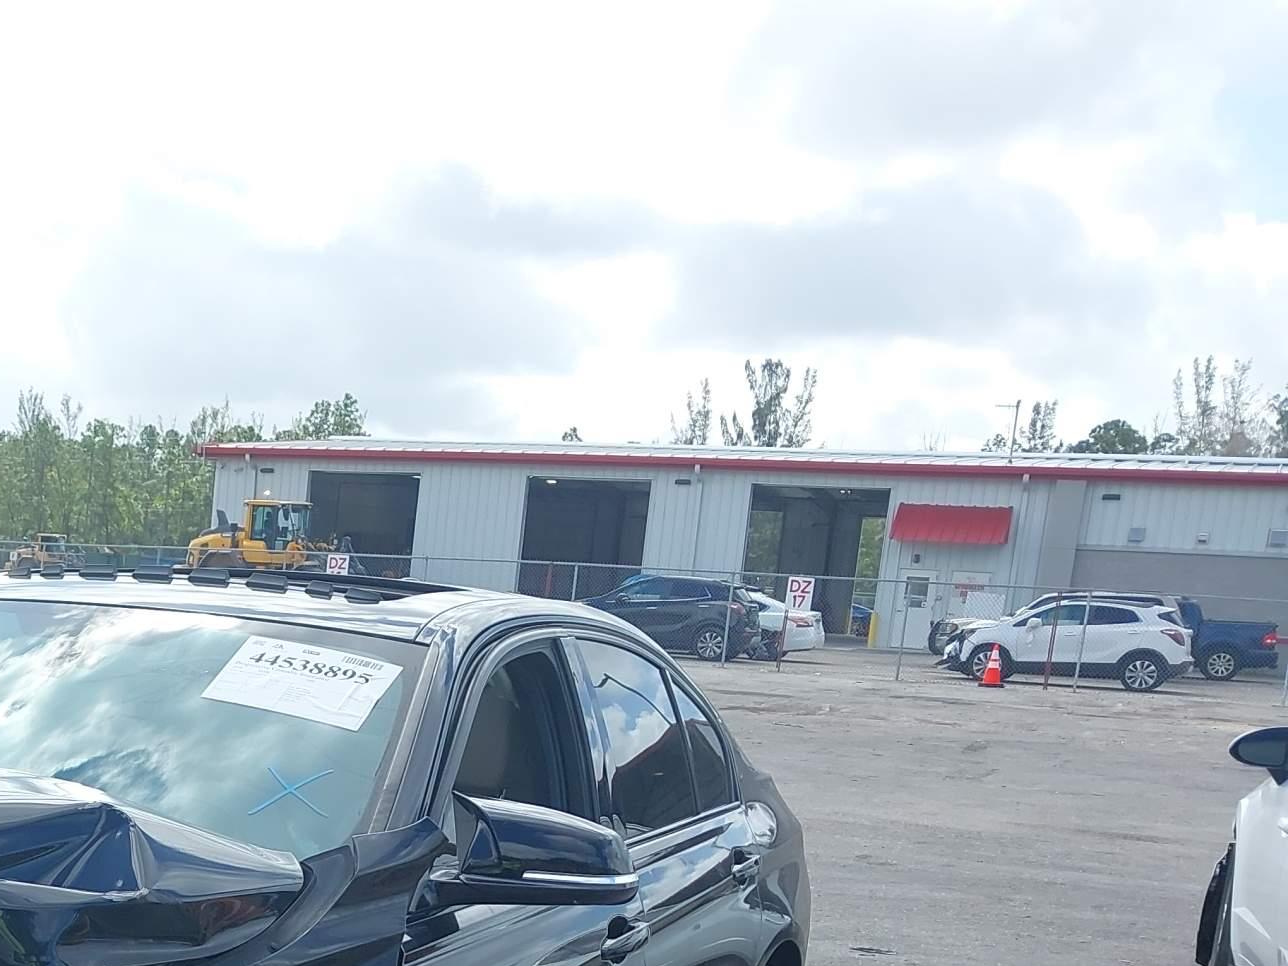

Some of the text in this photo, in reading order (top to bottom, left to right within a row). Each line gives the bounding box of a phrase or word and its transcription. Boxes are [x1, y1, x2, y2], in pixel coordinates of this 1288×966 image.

[328, 557, 347, 570] DZ
[789, 579, 812, 594] DZ
[792, 594, 806, 608] 17
[249, 651, 375, 685] 44538895
